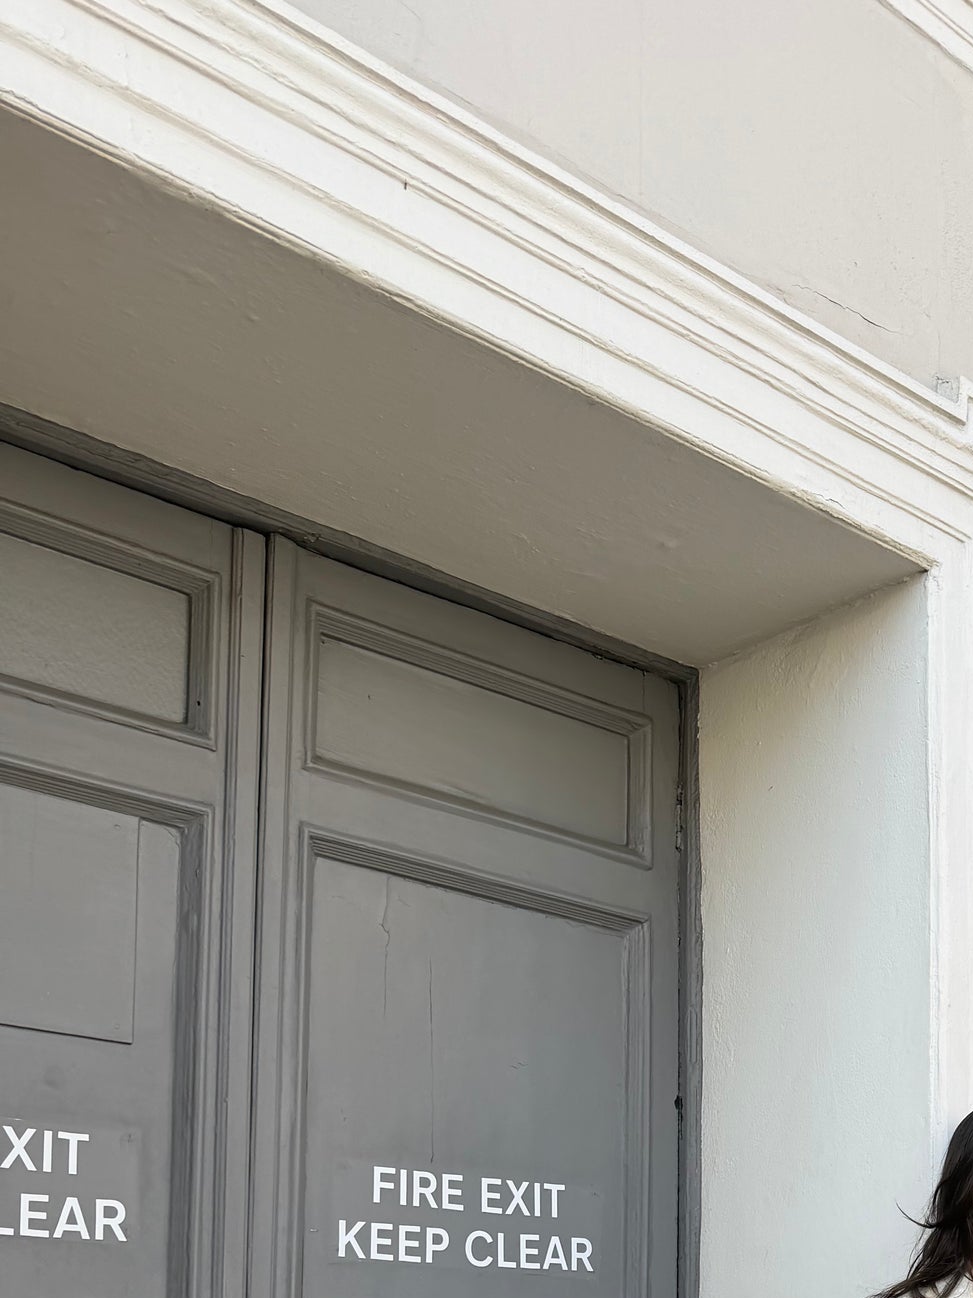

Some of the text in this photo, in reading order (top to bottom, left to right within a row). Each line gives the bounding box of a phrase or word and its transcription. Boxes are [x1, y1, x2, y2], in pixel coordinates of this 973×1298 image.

[0, 1125, 90, 1175] XIT
[0, 1193, 128, 1242] EAR
[373, 1166, 566, 1218] FIRE EXIT
[337, 1219, 594, 1272] KEEP CLEAR
